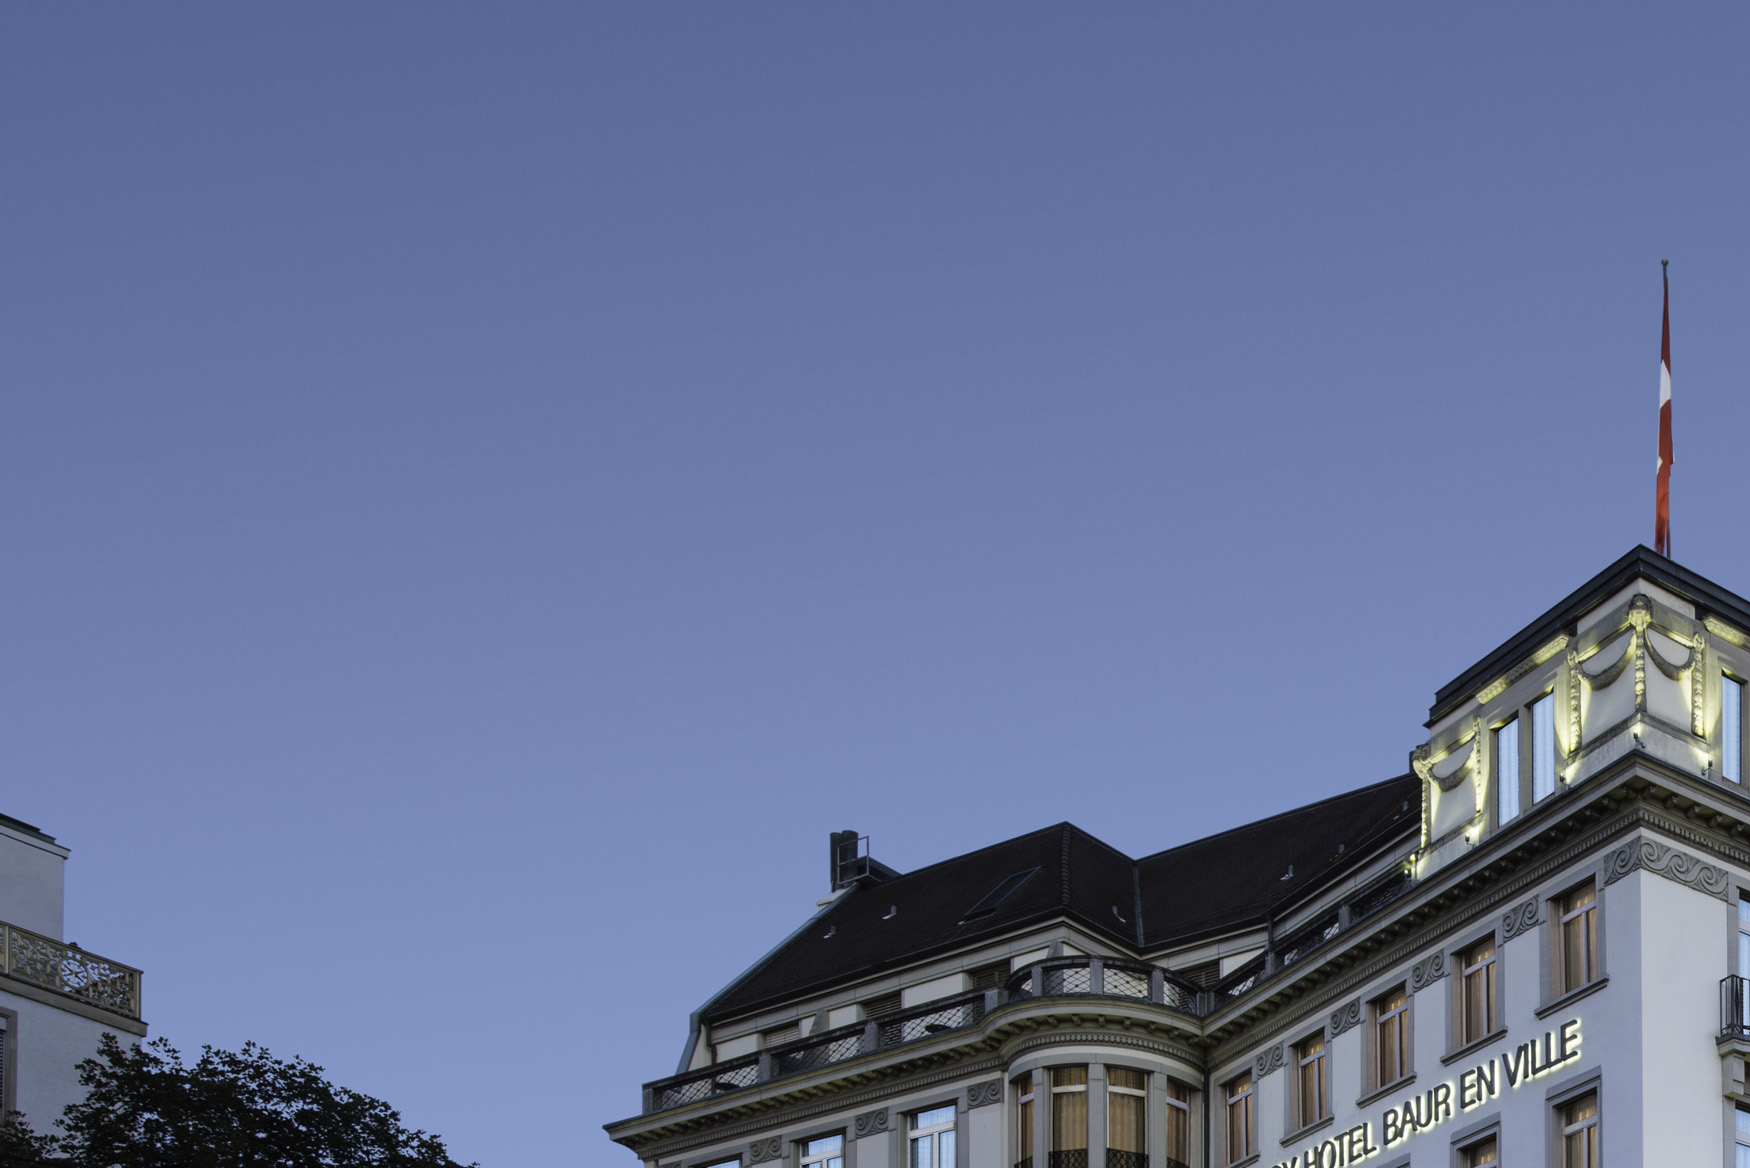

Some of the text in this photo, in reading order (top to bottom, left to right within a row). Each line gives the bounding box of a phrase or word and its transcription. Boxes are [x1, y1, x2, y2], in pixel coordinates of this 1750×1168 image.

[1382, 1081, 1452, 1147] BAUR
[1459, 1058, 1497, 1110] EN
[1501, 1018, 1580, 1088] VILLE
